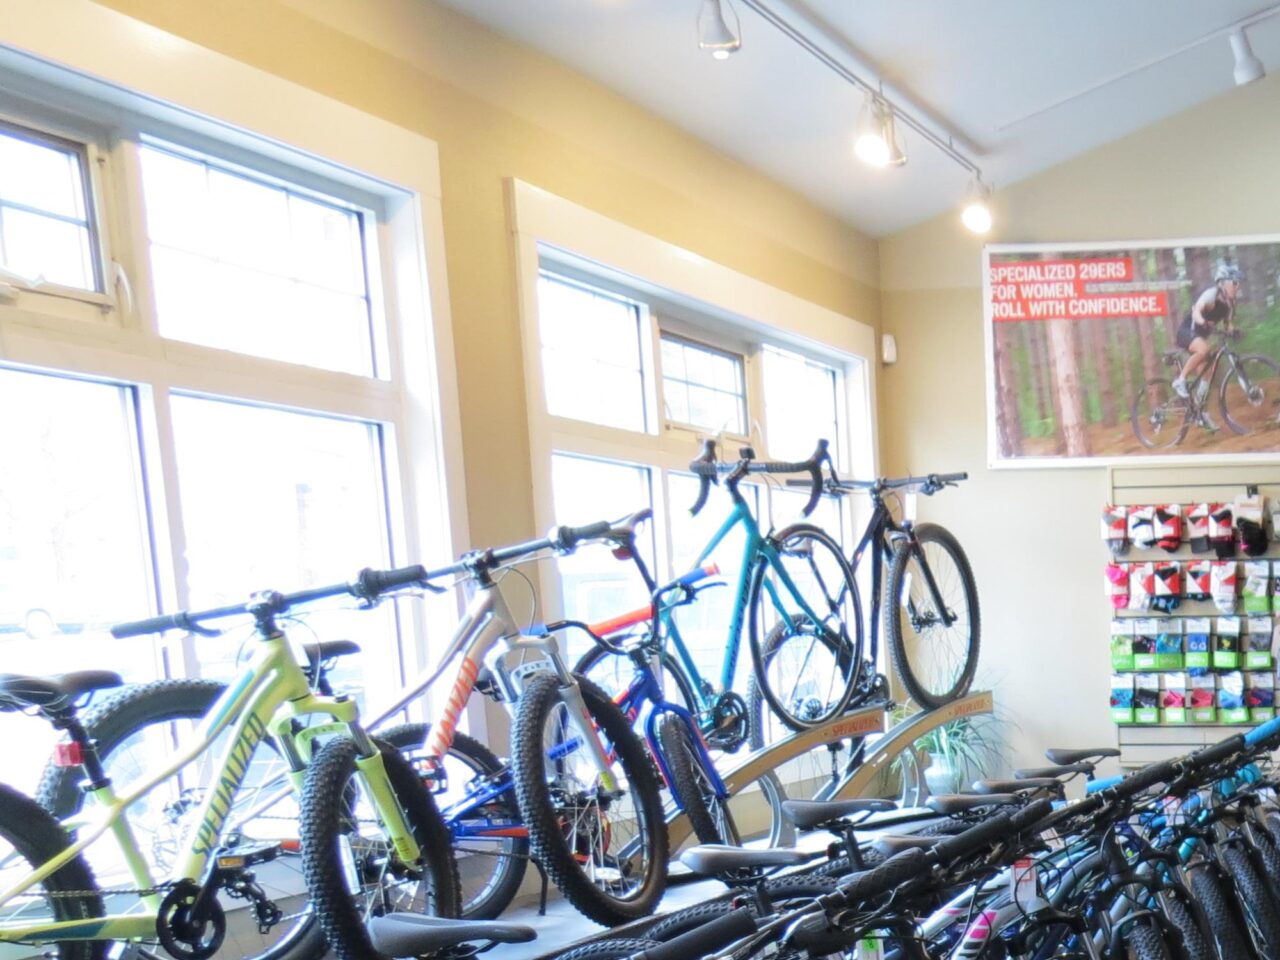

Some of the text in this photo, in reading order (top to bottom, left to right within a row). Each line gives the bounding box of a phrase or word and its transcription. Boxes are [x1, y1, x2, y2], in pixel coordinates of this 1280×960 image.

[990, 262, 1126, 281] SPECIALIZED 29ERS
[990, 284, 1016, 299] FOR
[1021, 281, 1078, 298] WOMEN.
[991, 296, 1162, 318] ROLL WITH CONFIDENCE.
[192, 711, 267, 856] SPECIALIZED
